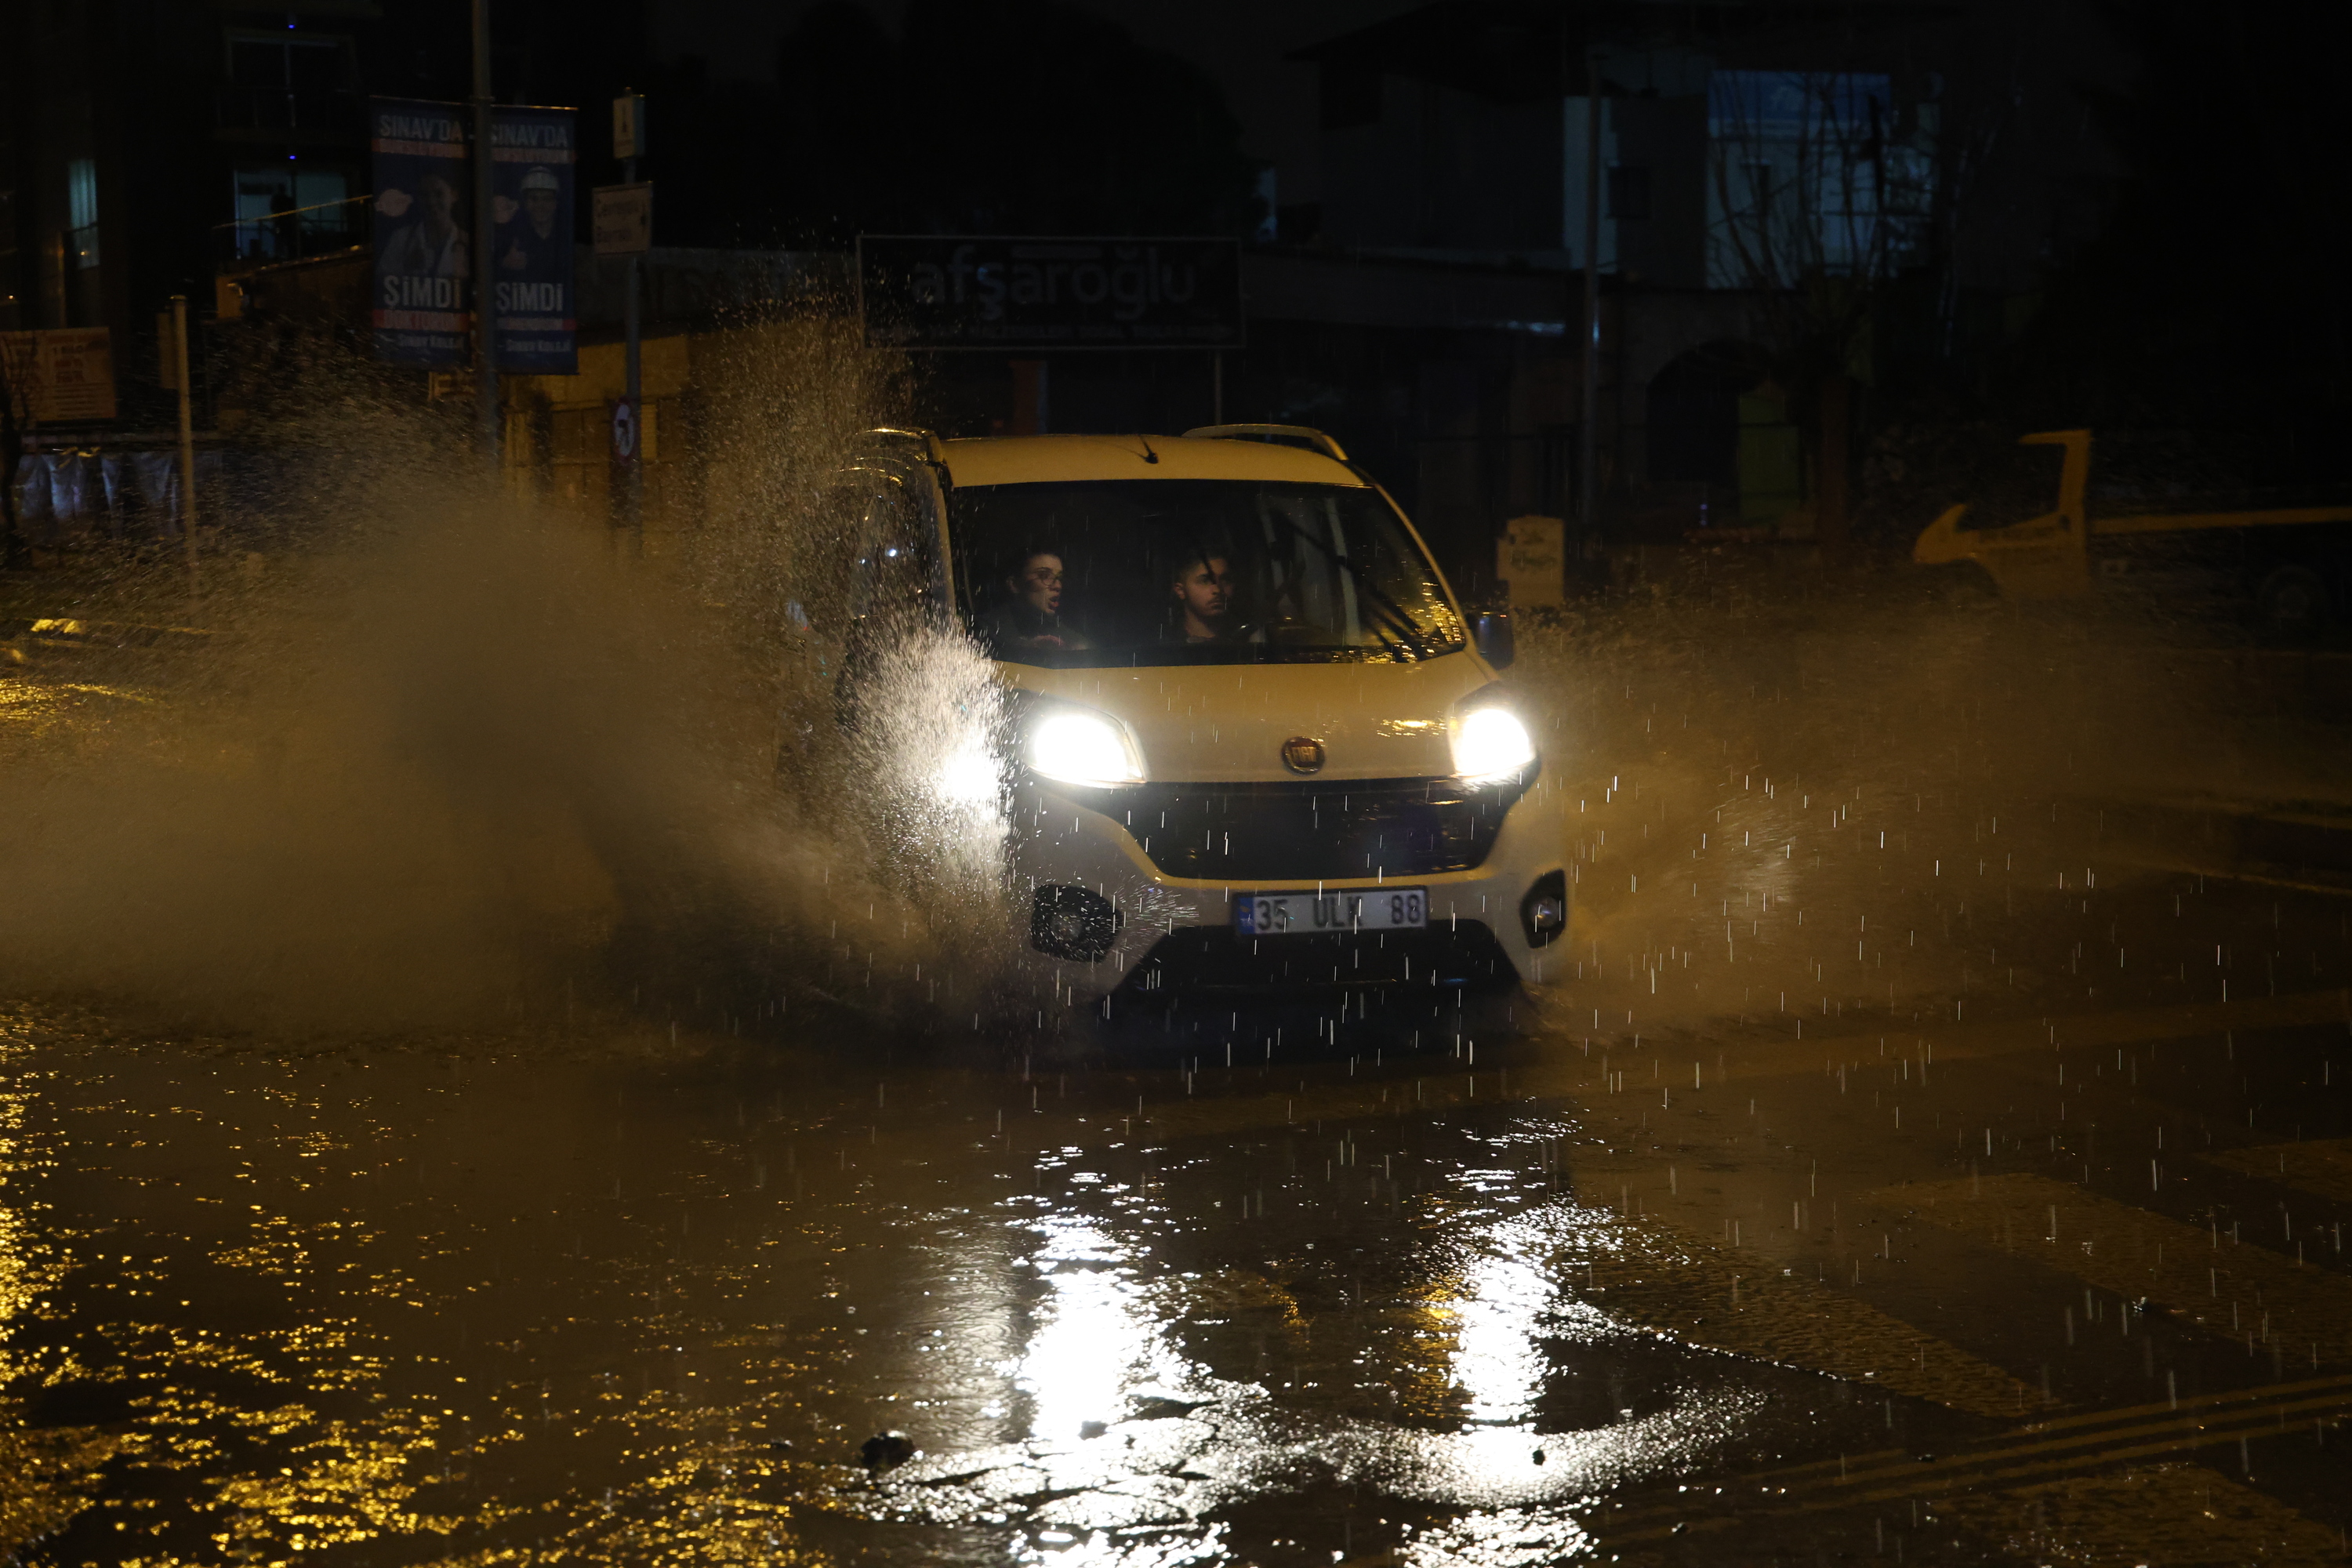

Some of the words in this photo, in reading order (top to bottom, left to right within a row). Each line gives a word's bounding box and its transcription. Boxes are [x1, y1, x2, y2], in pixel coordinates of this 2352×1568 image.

[910, 243, 1197, 321] afşaroğlu
[1257, 898, 1290, 931] 35
[1390, 894, 1421, 925] 88
